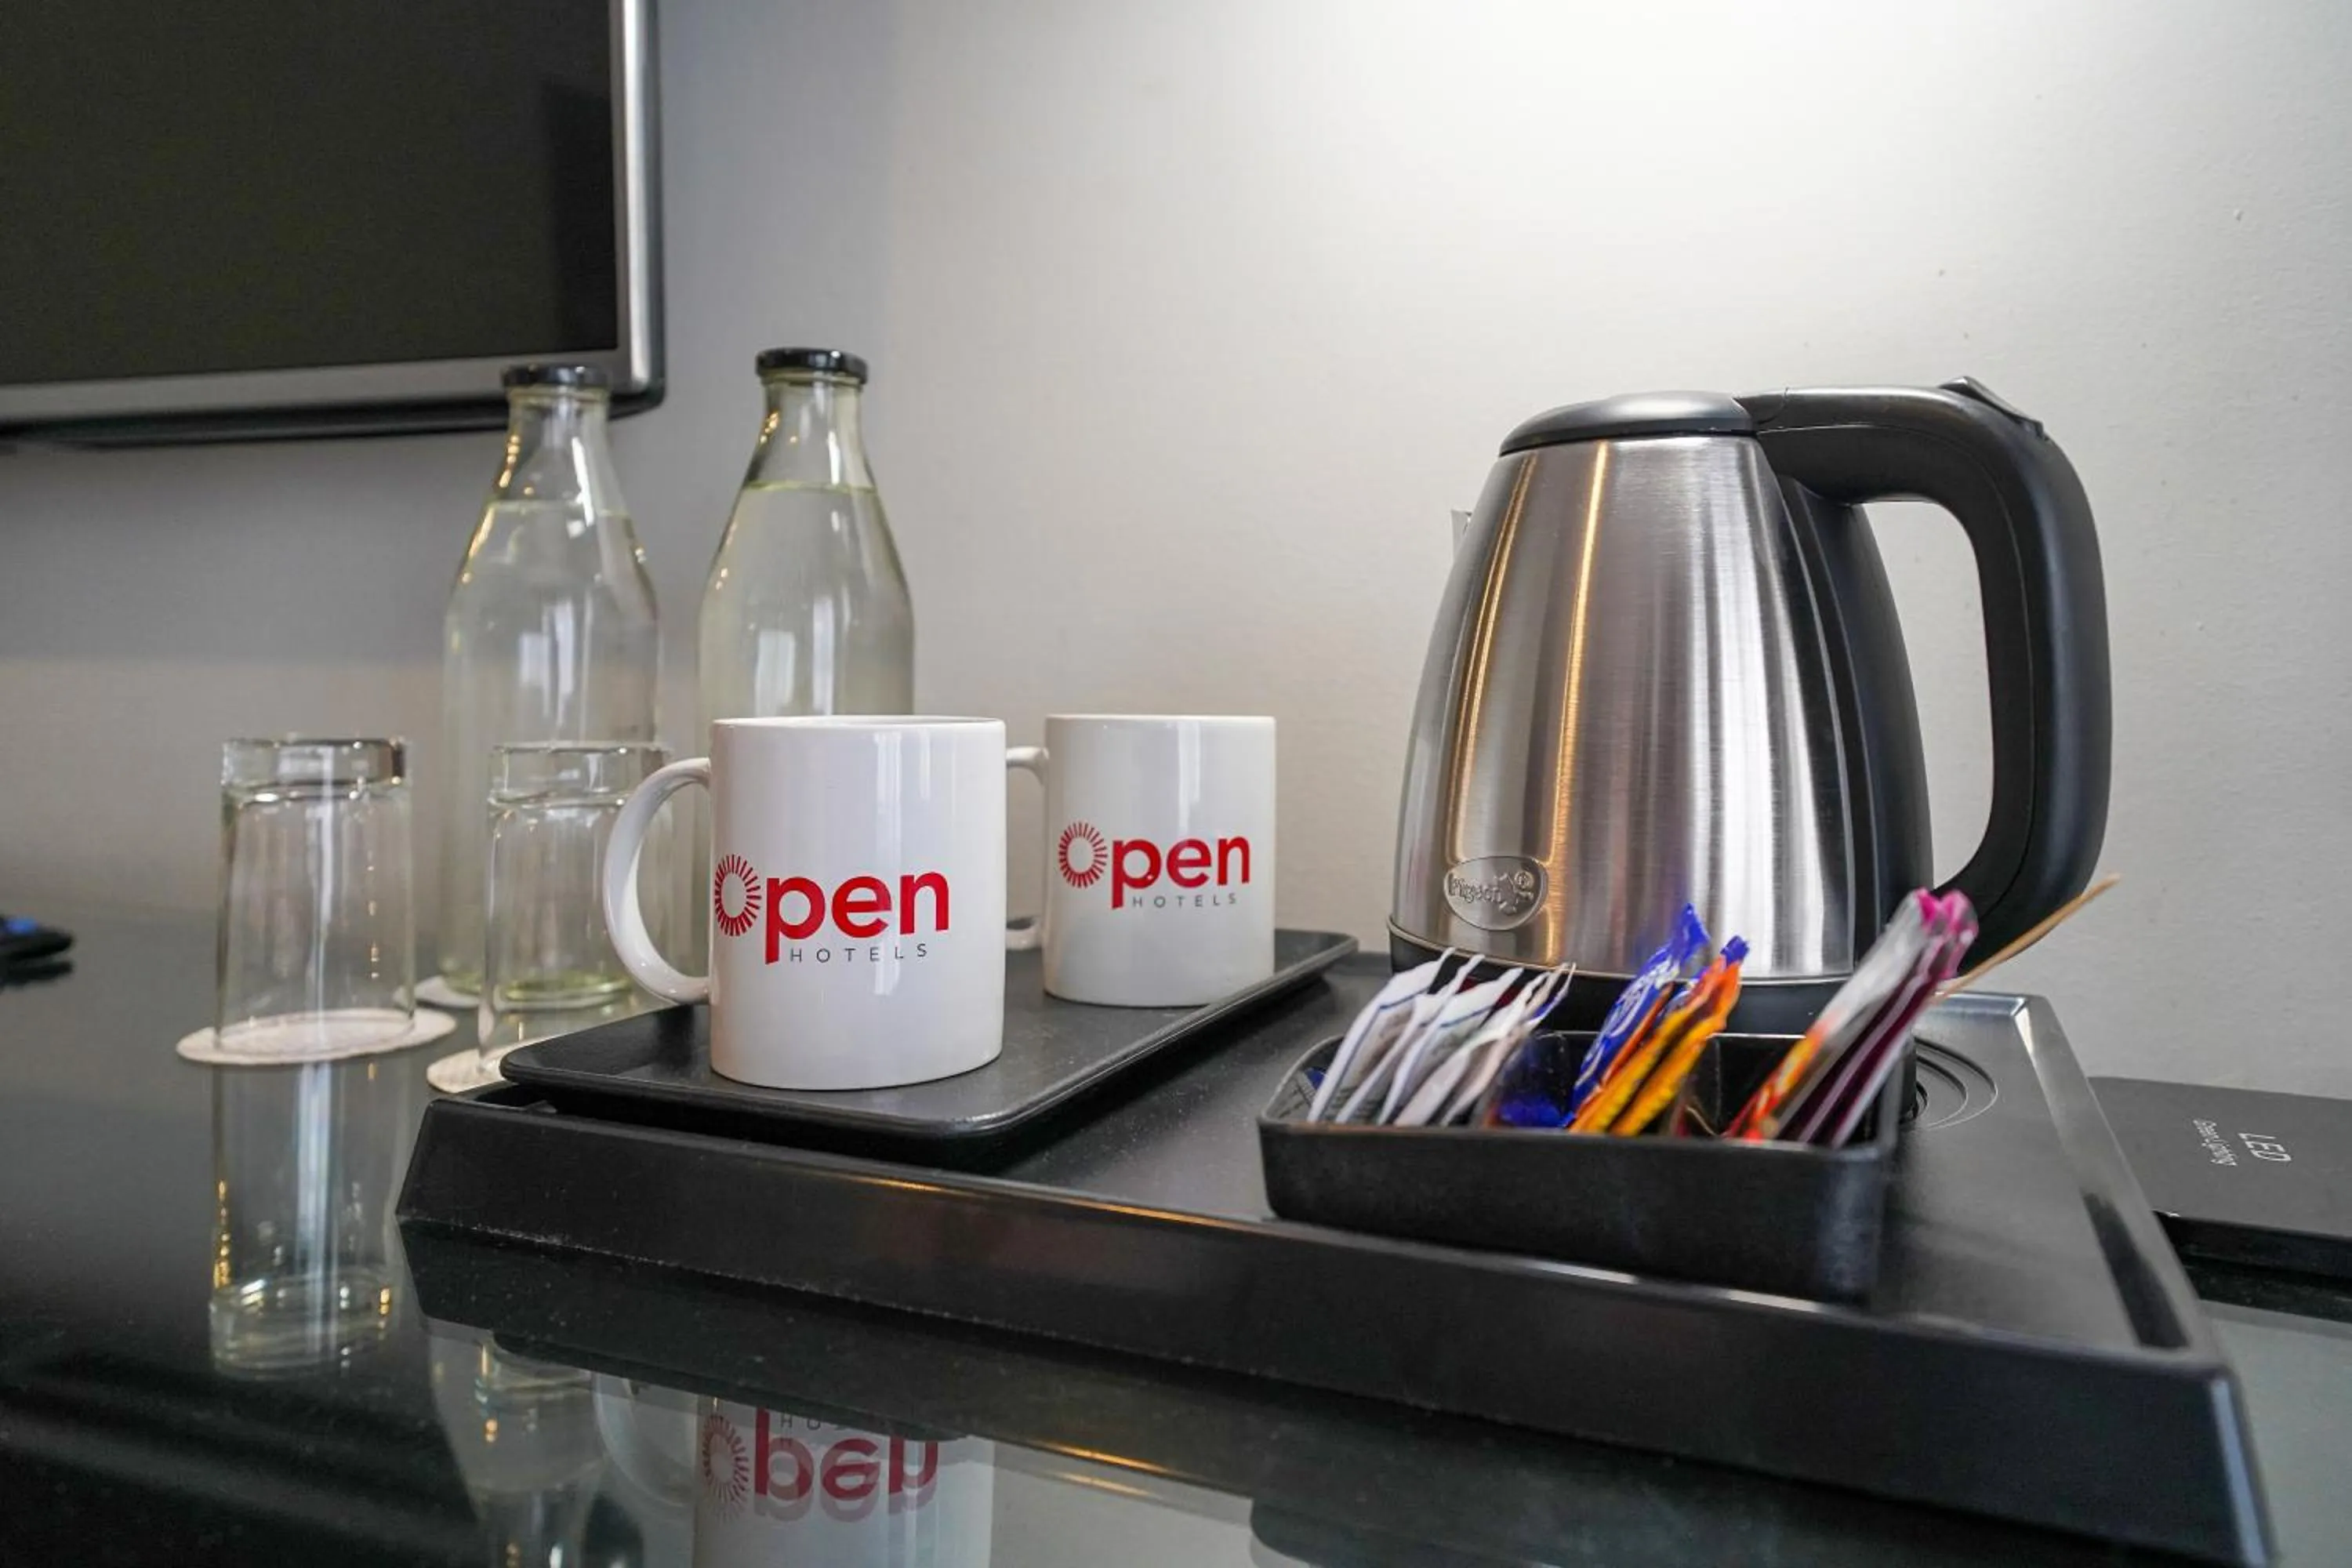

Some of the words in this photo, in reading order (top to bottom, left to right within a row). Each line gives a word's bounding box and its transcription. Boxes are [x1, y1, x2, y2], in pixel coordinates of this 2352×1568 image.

[1131, 892, 1237, 908] HOTELS
[789, 942, 928, 964] HOTELS
[2238, 1132, 2292, 1162] LED
